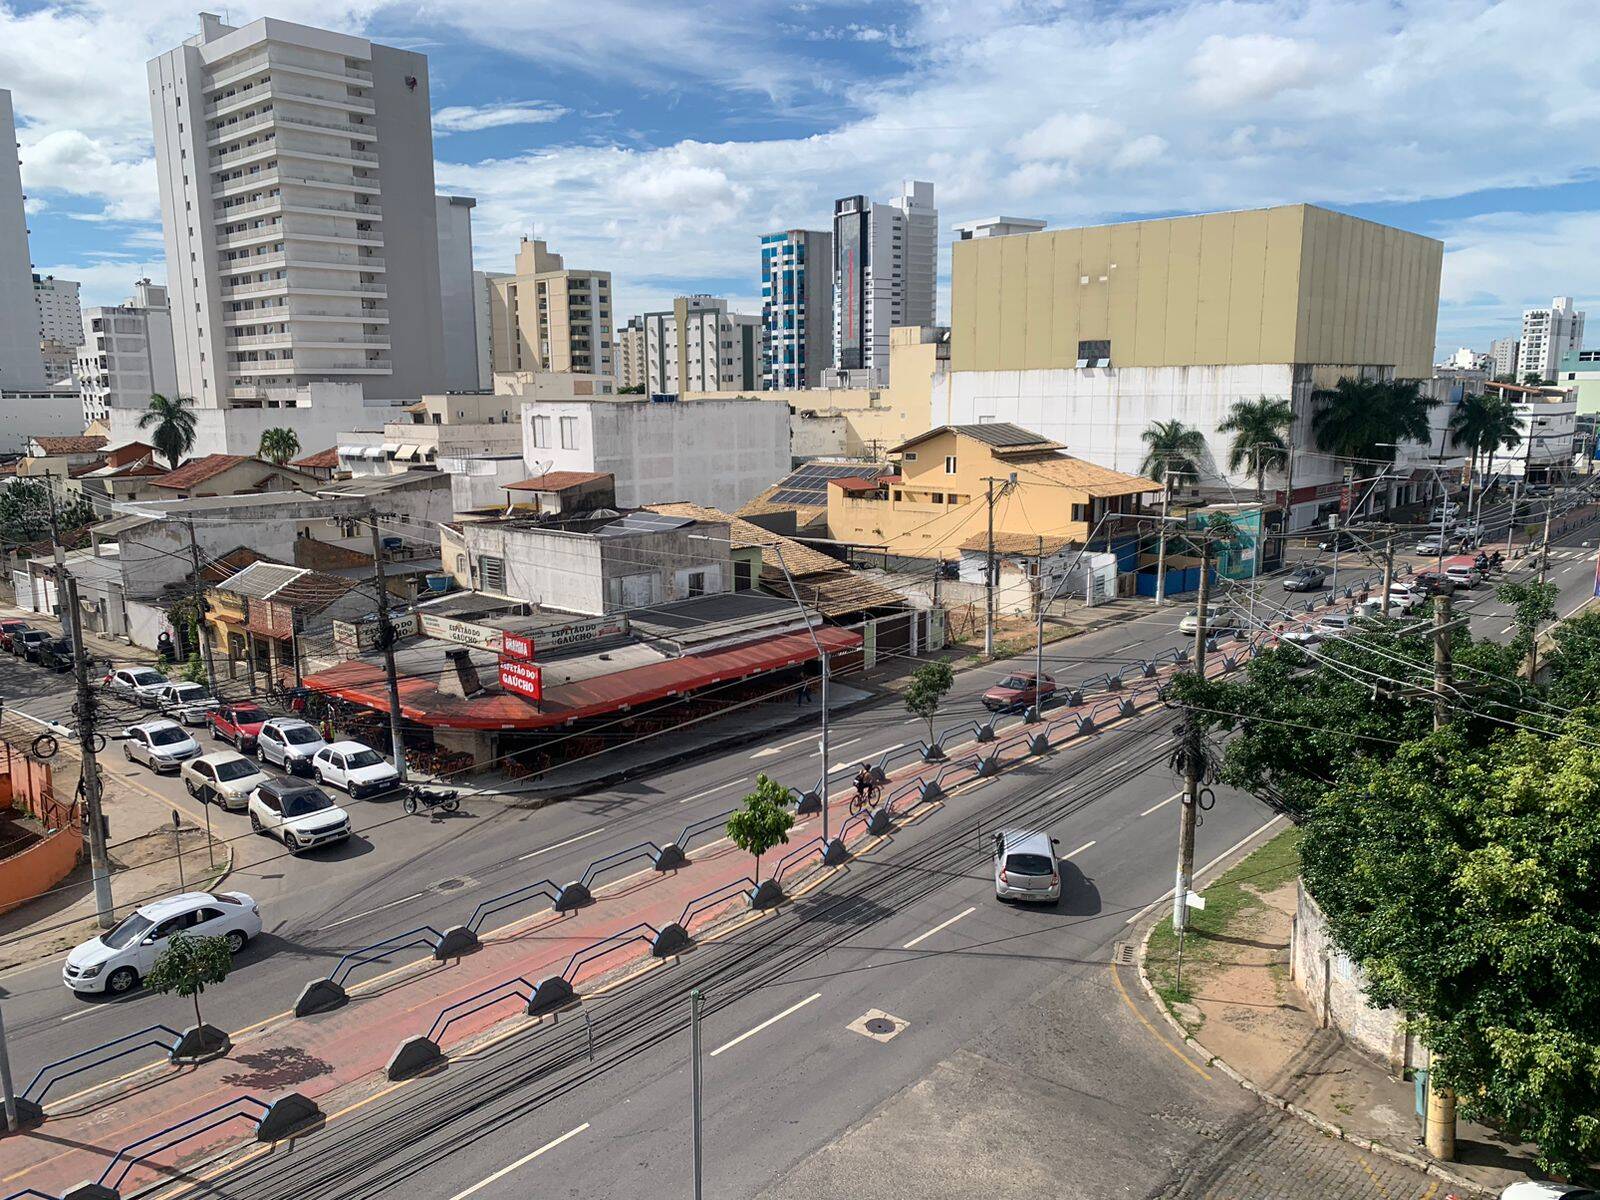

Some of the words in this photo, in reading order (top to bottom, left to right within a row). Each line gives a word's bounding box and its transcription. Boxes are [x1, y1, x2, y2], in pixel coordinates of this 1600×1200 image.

[551, 625, 585, 637] ESPETÃO
[585, 623, 597, 632] DO
[500, 662, 526, 676] ESPETÃO
[526, 669, 536, 680] DO
[502, 674, 535, 693] GAÚCHO
